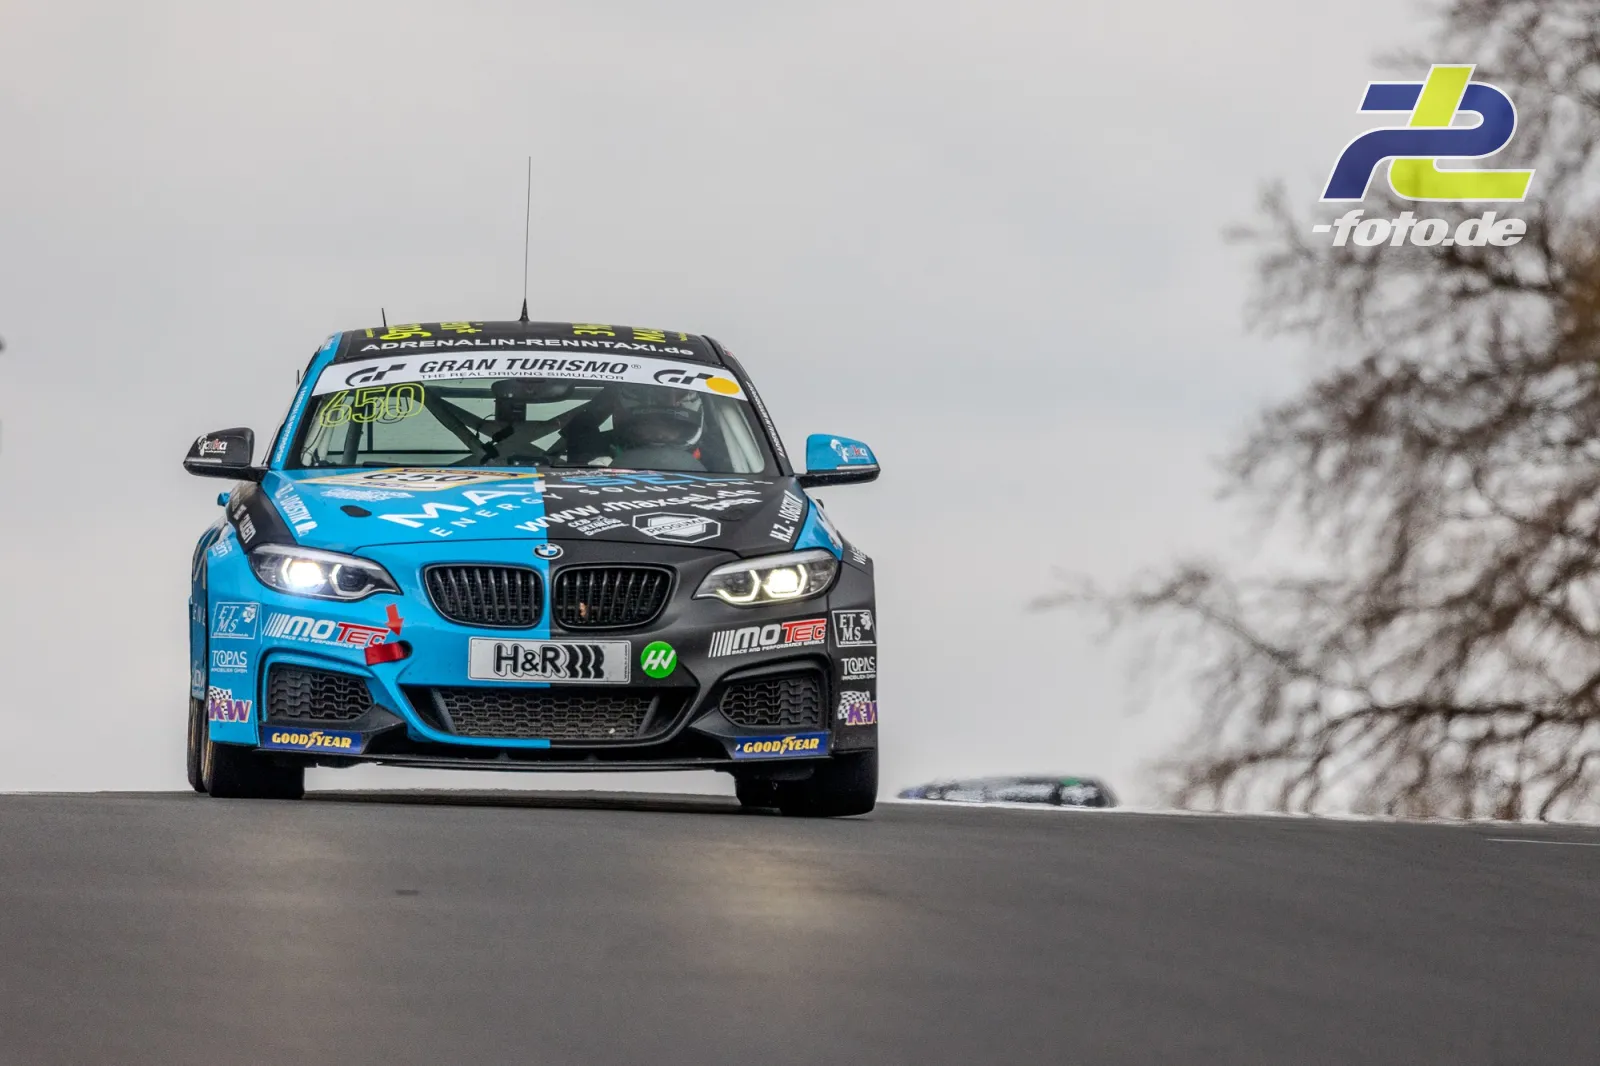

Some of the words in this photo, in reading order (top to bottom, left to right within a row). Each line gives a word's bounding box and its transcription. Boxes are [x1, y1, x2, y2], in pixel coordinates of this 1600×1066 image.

[360, 337, 695, 356] ADRENALIN-RENNTAXI.de
[418, 358, 498, 374] GRAN
[547, 372, 625, 381] SIMULATOR
[319, 382, 426, 428] 650
[362, 471, 480, 483] 650
[428, 492, 564, 538] ENERGY
[839, 613, 857, 628] ET
[842, 626, 862, 641] MS
[211, 649, 248, 668] TOPAS
[493, 642, 568, 678] H&R
[841, 655, 876, 675] TOPAS
[208, 698, 253, 723] KW
[271, 730, 352, 749] GOODYEAR
[742, 735, 820, 754] GOODYEAR
